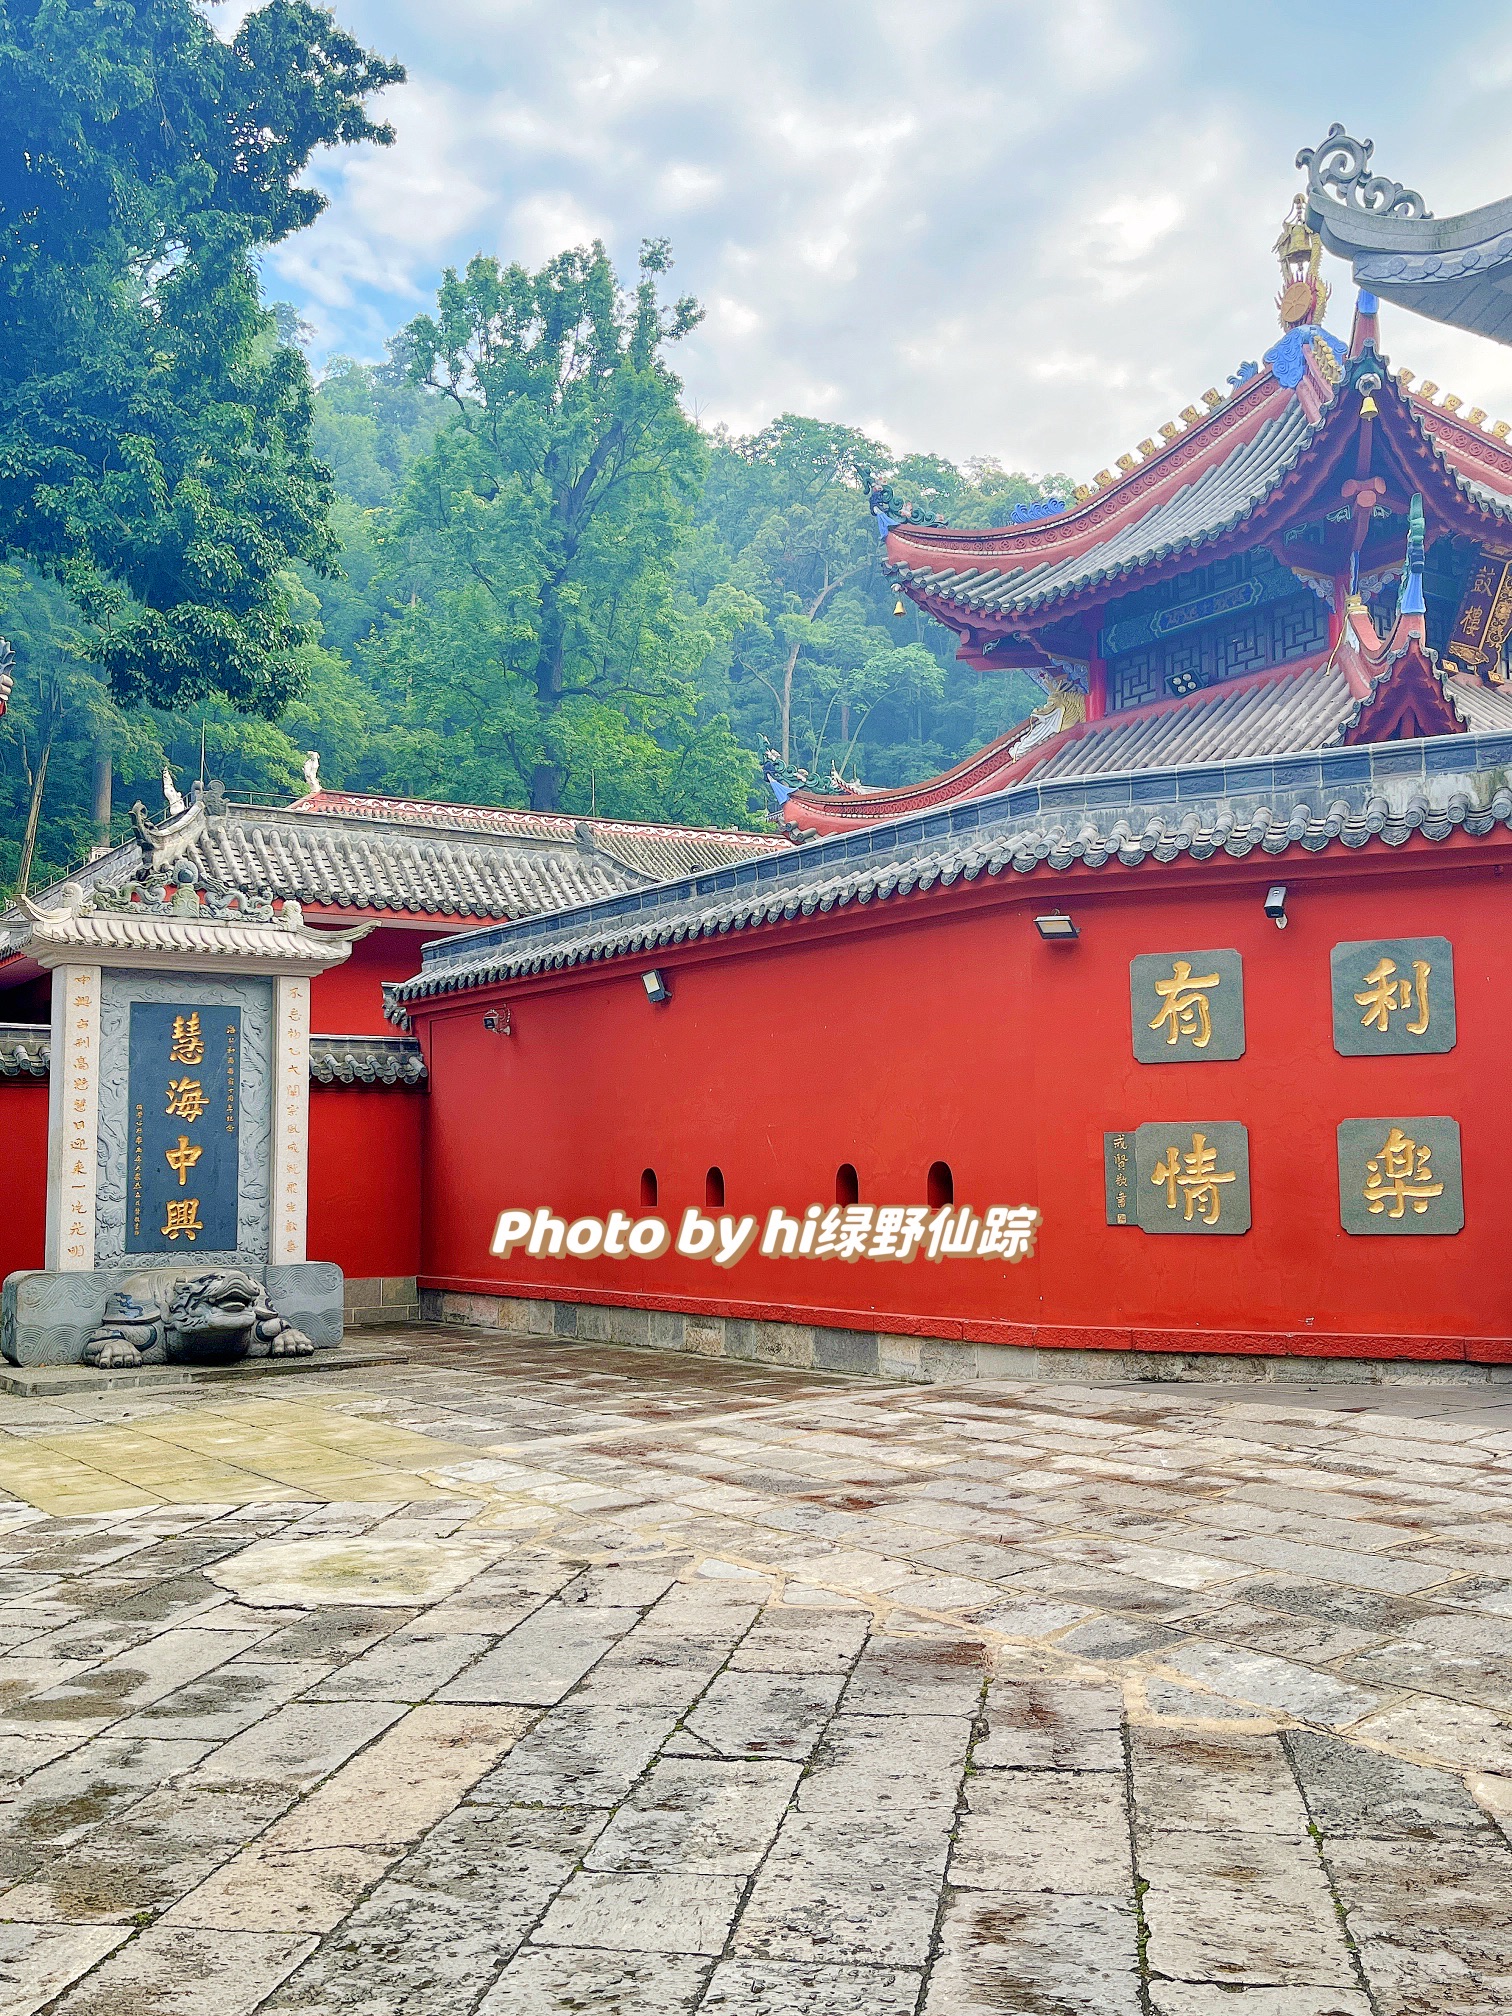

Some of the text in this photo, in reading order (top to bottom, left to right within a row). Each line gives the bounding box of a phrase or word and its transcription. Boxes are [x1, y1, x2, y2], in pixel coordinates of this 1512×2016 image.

[1460, 566, 1495, 637] 鼓樓
[1149, 961, 1220, 1047] 有
[1354, 958, 1431, 1034] 利
[161, 1011, 210, 1241] 慧海中興
[1151, 1132, 1236, 1224] 情
